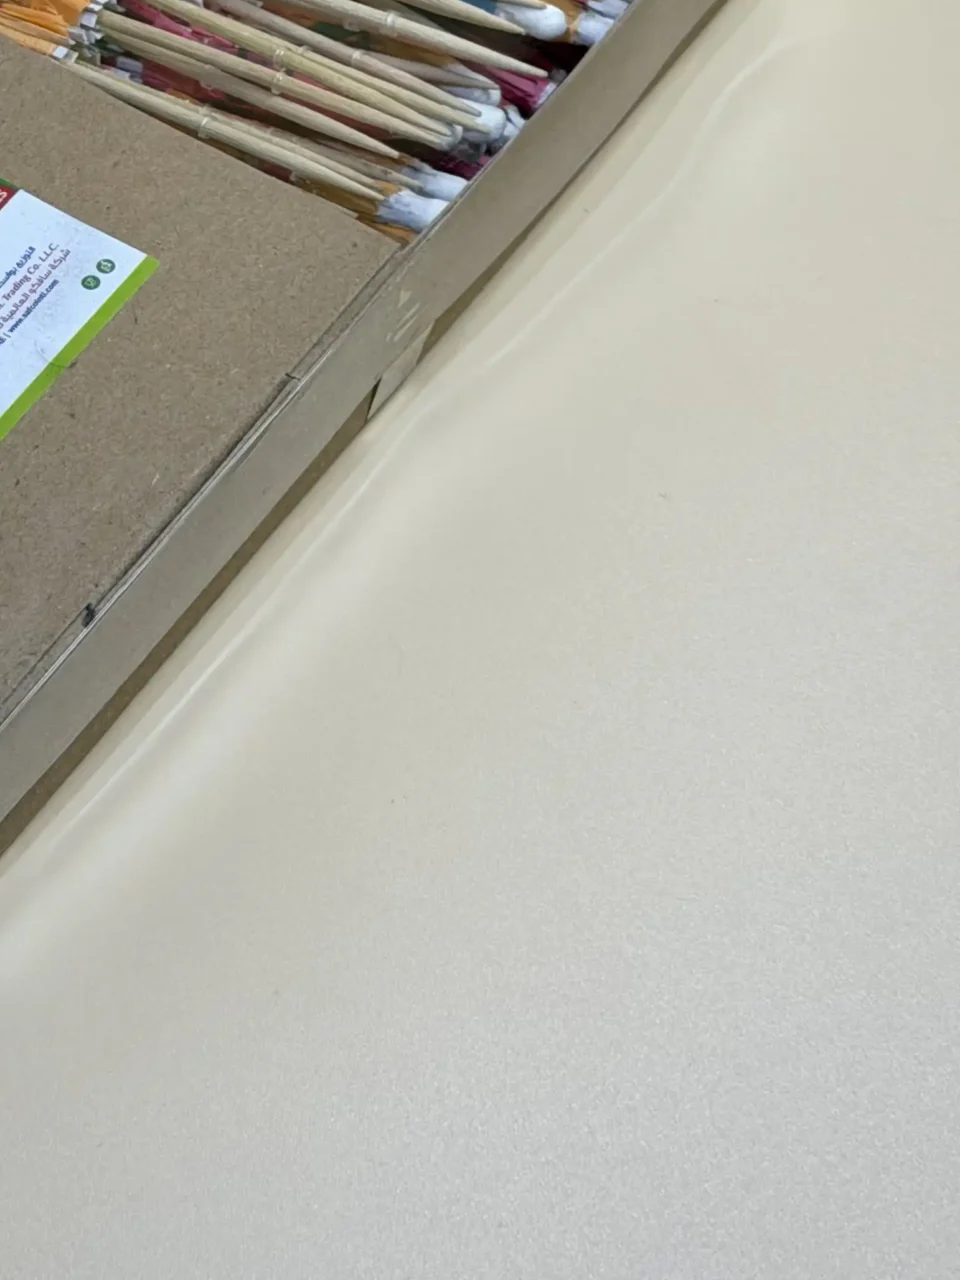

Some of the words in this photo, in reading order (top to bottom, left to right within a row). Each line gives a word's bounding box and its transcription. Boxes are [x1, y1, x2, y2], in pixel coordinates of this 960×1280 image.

[15, 245, 36, 269] التوزيع
[47, 248, 72, 271] شركة
[1, 274, 32, 301] Trading
[26, 263, 42, 275] Co.
[28, 269, 53, 295] سافكو
[0, 292, 31, 323] العالمية
